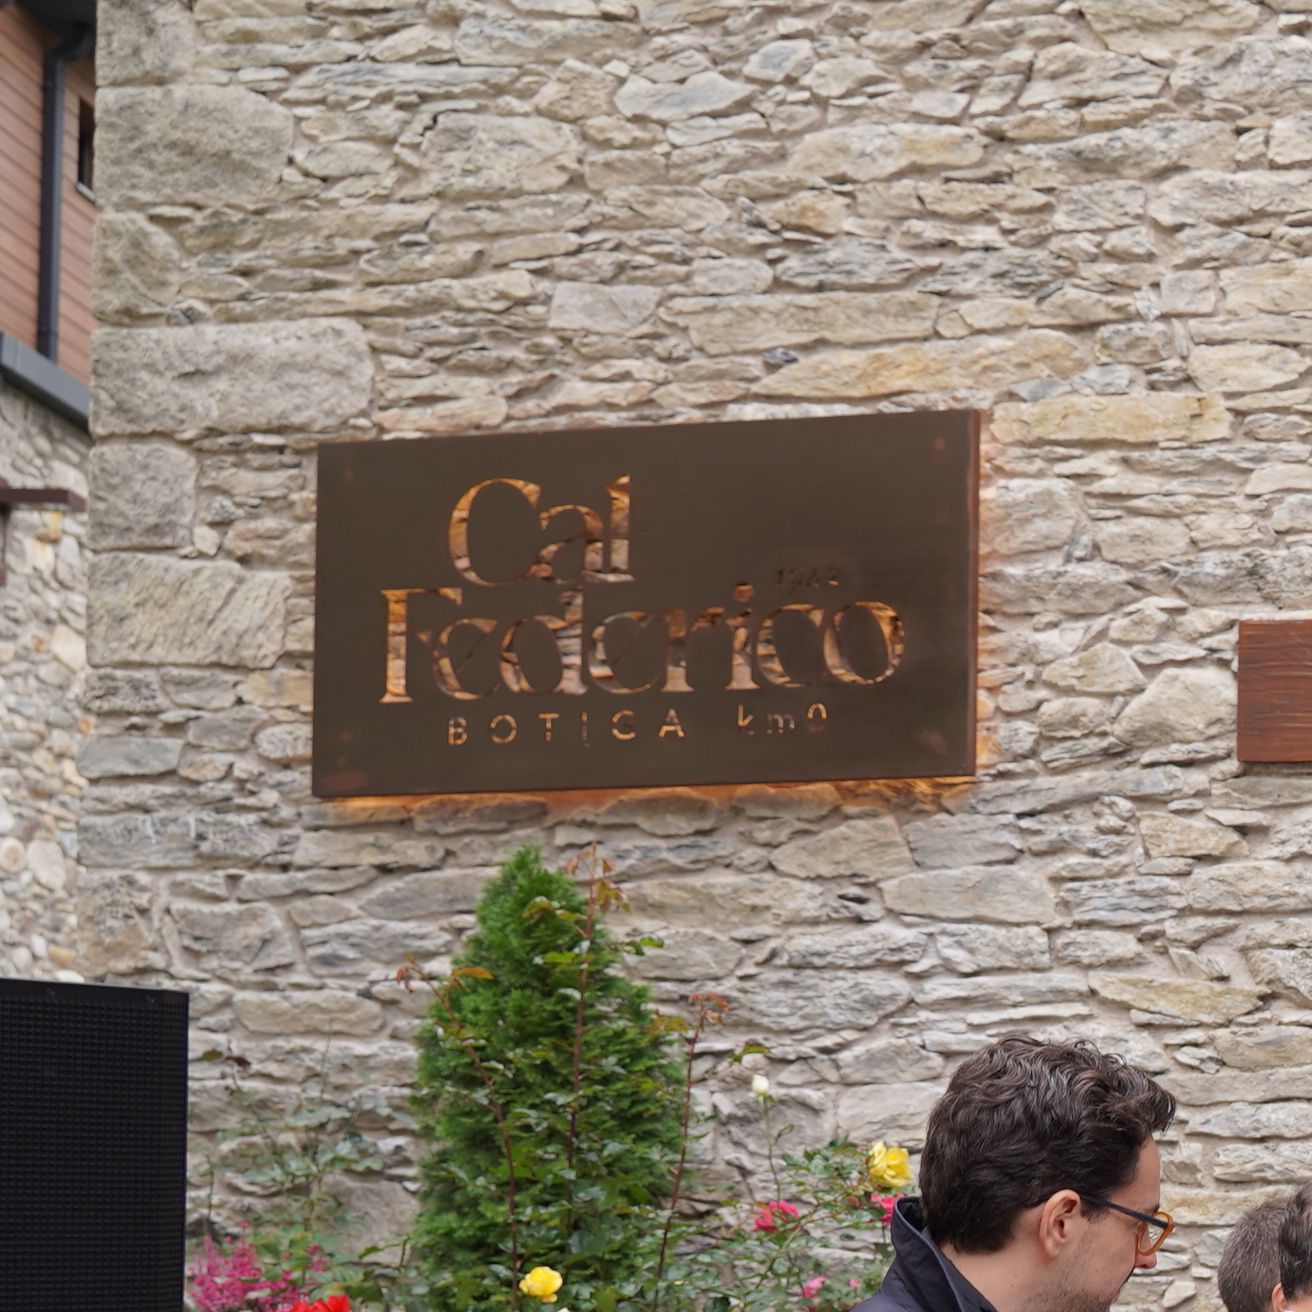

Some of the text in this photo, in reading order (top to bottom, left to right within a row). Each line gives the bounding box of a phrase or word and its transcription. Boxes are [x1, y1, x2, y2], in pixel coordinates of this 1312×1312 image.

[447, 474, 637, 586] Cal
[378, 581, 905, 704] Federico
[447, 707, 686, 748] BOTICA
